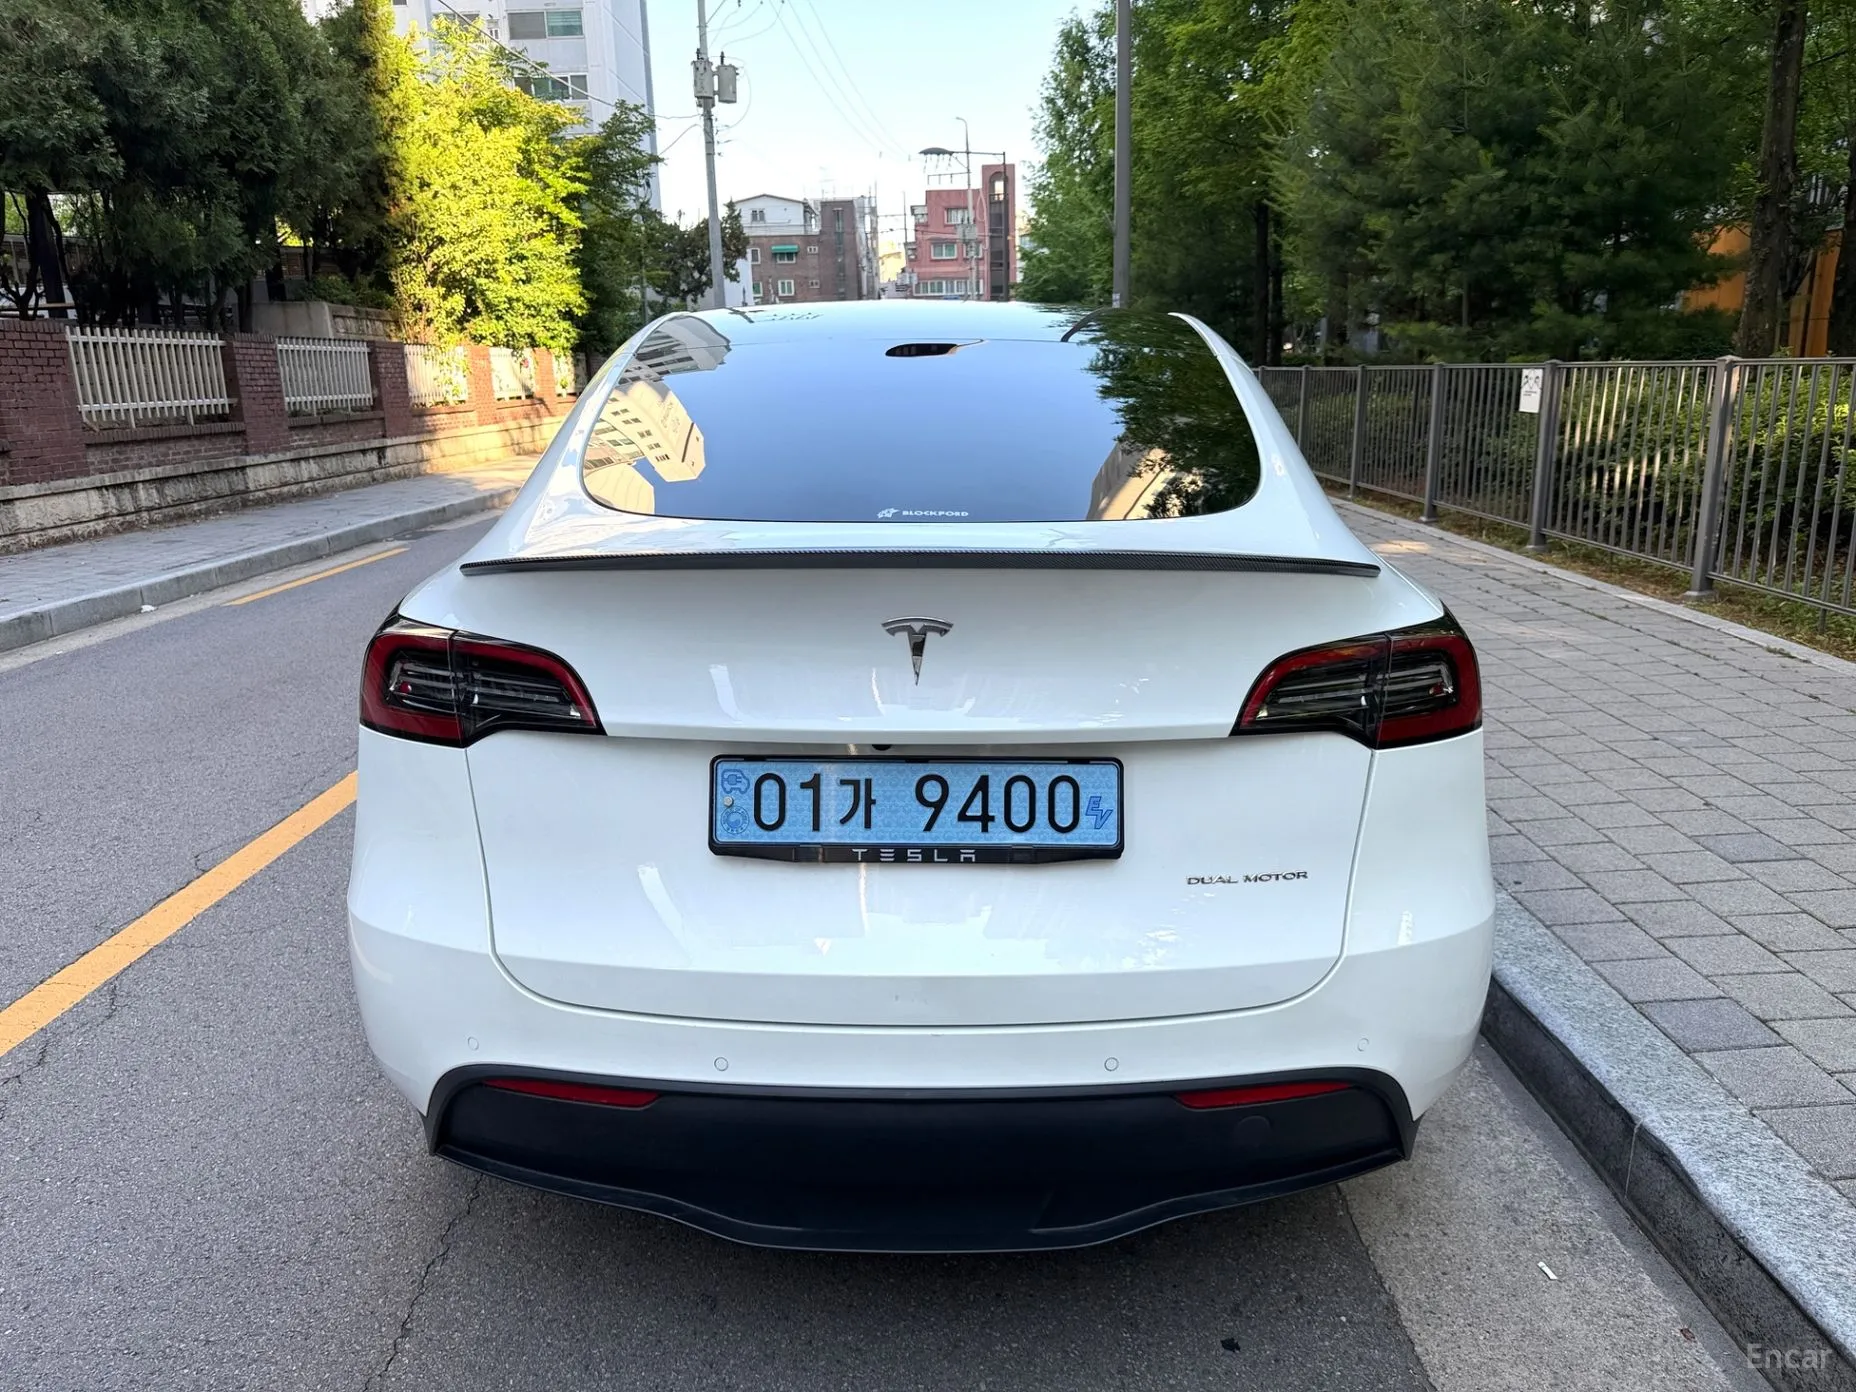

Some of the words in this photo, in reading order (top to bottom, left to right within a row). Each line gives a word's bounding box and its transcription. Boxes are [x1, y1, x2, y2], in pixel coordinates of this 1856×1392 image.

[753, 772, 876, 832] 01가
[915, 773, 1080, 833] 9400
[1085, 796, 1113, 830] EV
[852, 849, 976, 863] TESLA
[1187, 875, 1239, 885] DUAL
[1243, 871, 1308, 883] MOTOR
